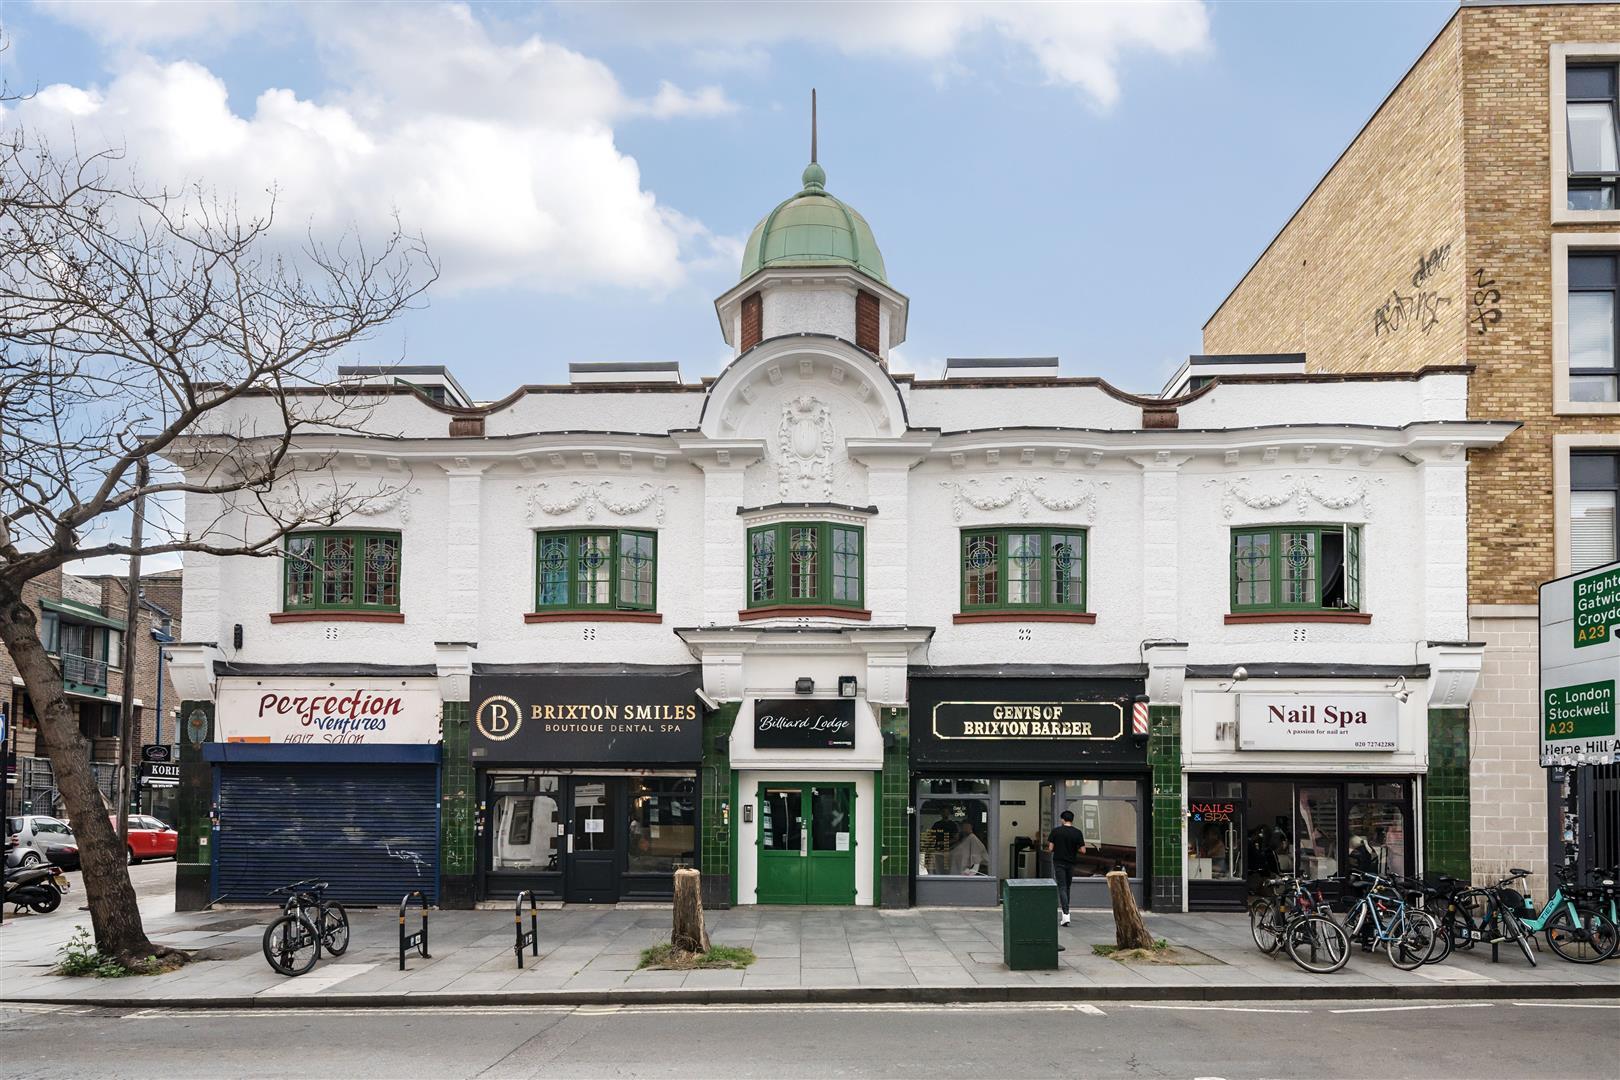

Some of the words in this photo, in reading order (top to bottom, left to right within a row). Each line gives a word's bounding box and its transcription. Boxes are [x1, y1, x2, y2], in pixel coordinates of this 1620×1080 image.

[1549, 693, 1560, 705] C.
[1566, 688, 1610, 703] London
[258, 689, 404, 726] Perfection
[530, 704, 618, 720] BRIXTON
[623, 704, 697, 720] SMILES
[993, 706, 1041, 720] GENTS
[1043, 706, 1063, 720] OF
[1550, 701, 1610, 720] Stockwell
[759, 715, 810, 731] Billiard
[809, 715, 850, 733] Lodge
[1268, 705, 1316, 724] Nail
[1323, 705, 1368, 728] Spa
[545, 724, 604, 733] BOUTIQUE
[610, 724, 654, 733] DENTAL
[660, 724, 681, 733] SPA
[964, 721, 1029, 736] BRIXTON
[1031, 721, 1093, 736] BARBER
[1586, 740, 1608, 753] Hill
[1191, 803, 1234, 813] NAILS
[1194, 813, 1202, 821] &
[1204, 812, 1231, 822] SPA
